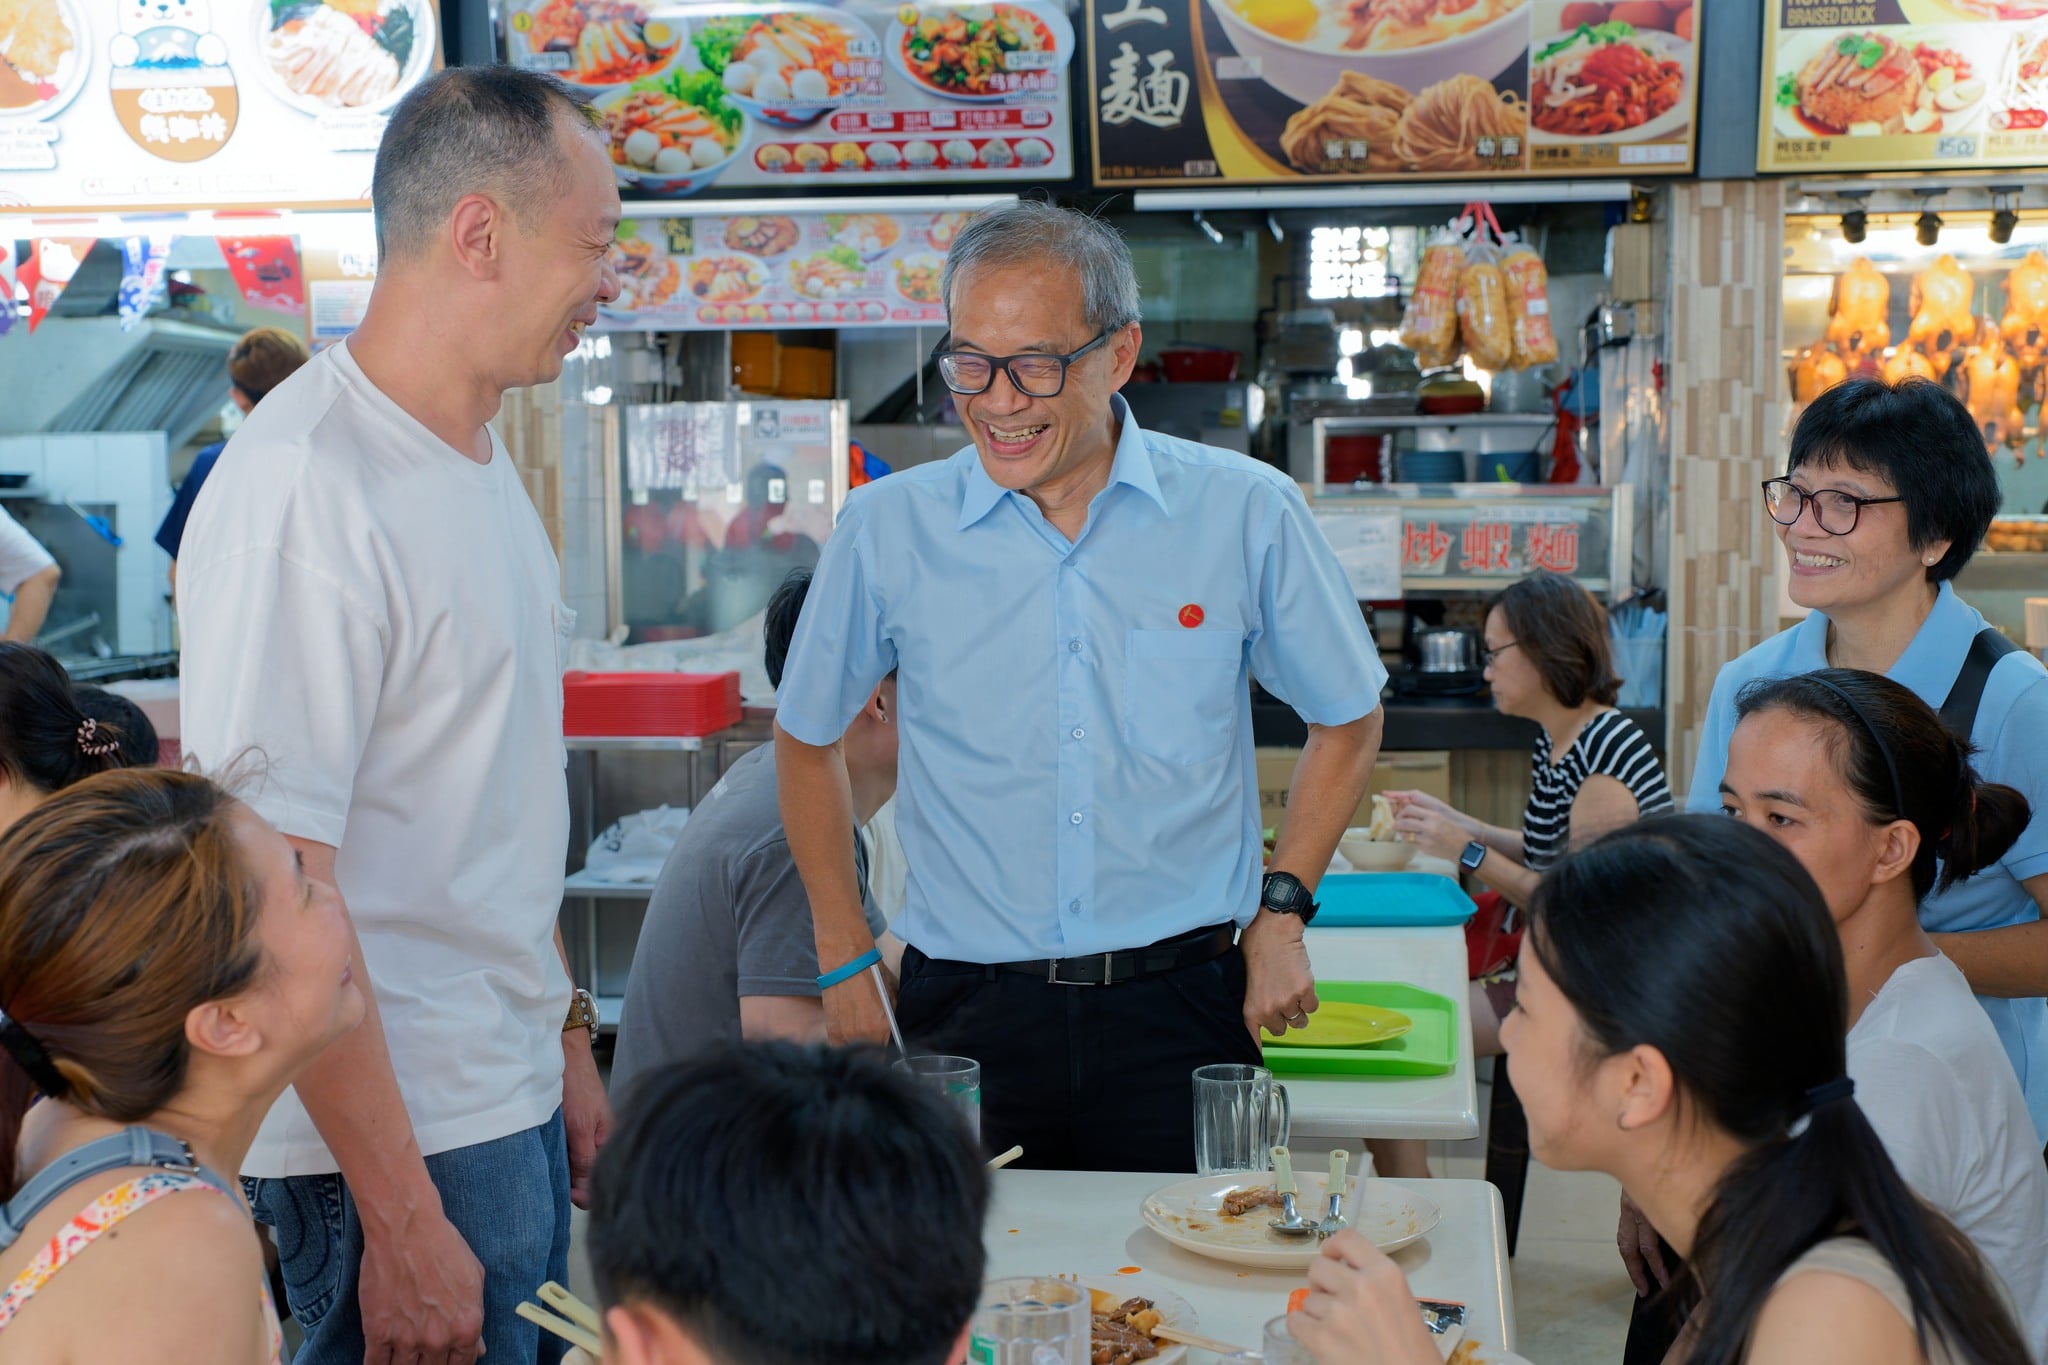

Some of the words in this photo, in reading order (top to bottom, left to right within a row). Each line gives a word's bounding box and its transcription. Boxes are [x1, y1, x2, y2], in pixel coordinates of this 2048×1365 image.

[1787, 8, 1840, 27] BRAISED
[1841, 5, 1876, 24] DUCK
[1401, 521, 1579, 573] 炒蝦麵
